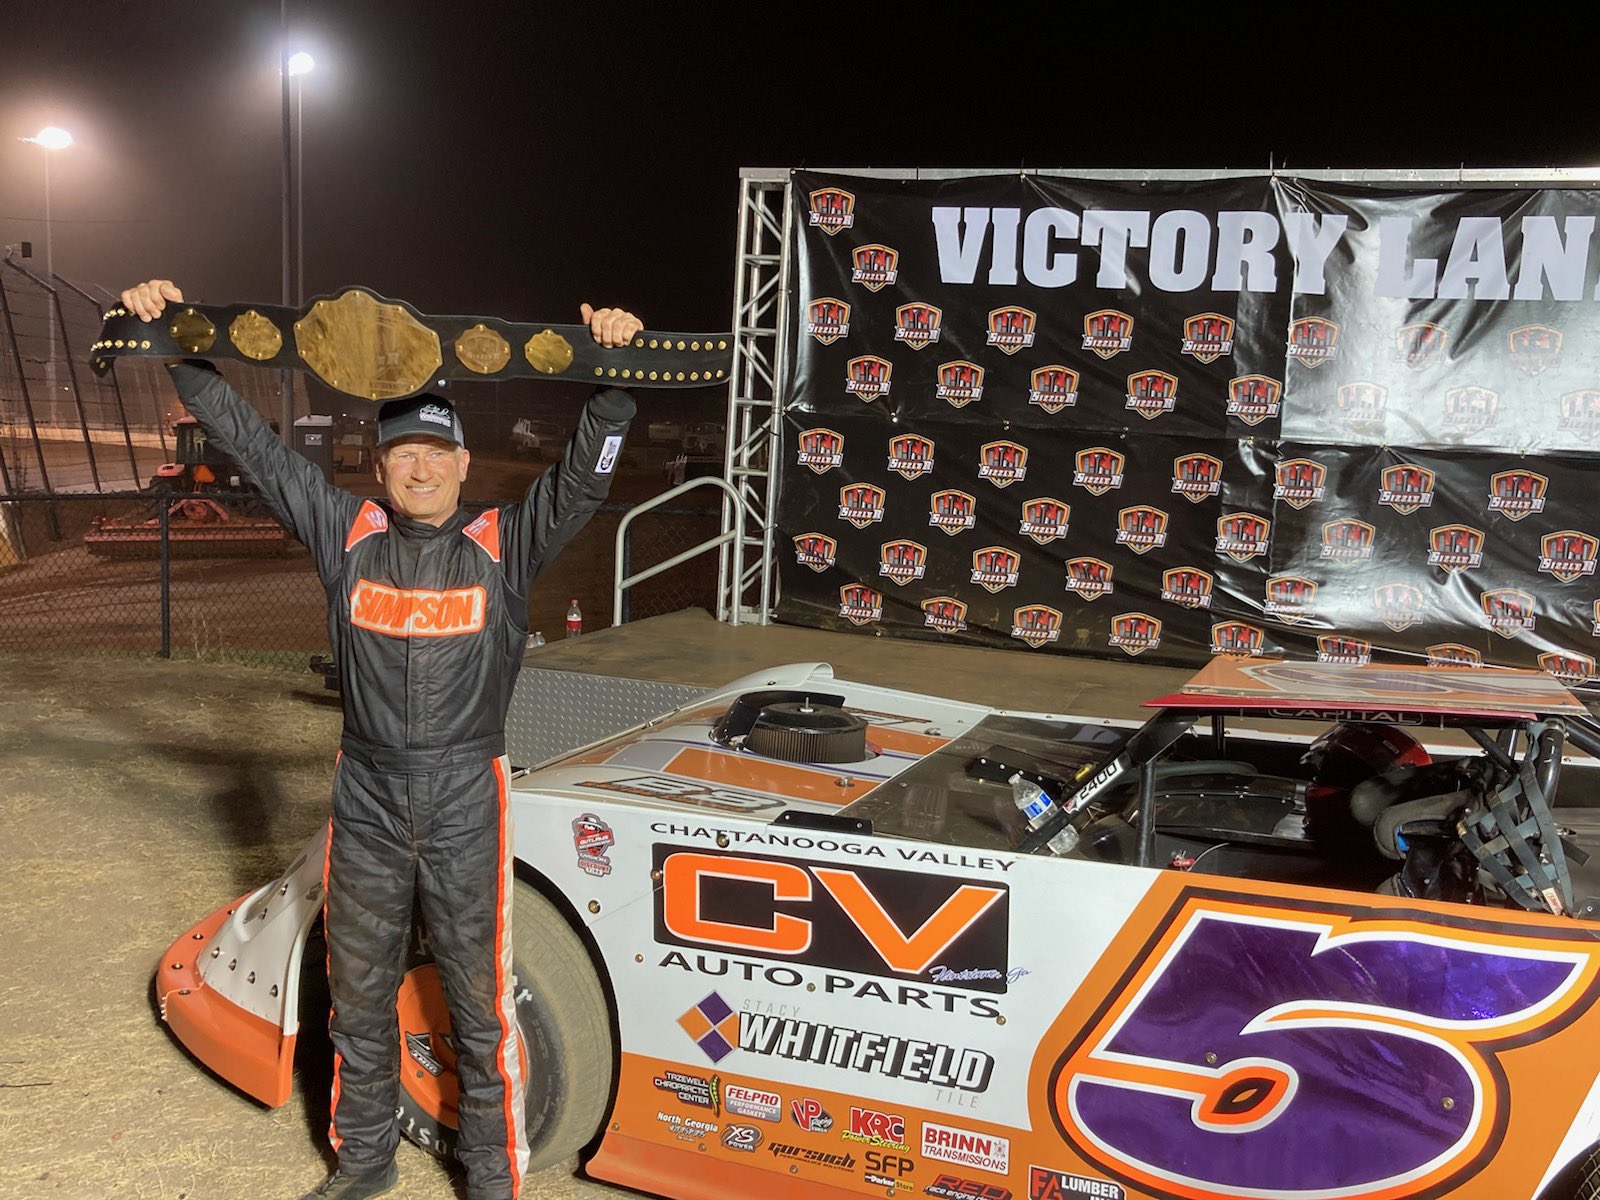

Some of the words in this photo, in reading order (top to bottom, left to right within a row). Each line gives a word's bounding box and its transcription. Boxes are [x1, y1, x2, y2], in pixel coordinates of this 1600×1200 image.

[812, 212, 852, 226] SIZZLER
[931, 206, 1348, 295] VICTORY
[1372, 215, 1600, 301] LAN
[854, 269, 894, 281] SIZZLER
[806, 323, 847, 335] SIZZLER
[896, 328, 938, 340] SIZZLER
[989, 332, 1033, 344] SIZZLER
[1084, 336, 1130, 348] SIZZLER
[1184, 340, 1230, 352] SIZZLER
[1288, 344, 1336, 356] SIZZLER
[848, 380, 888, 392] SIZZLER
[939, 386, 980, 398] SIZZLER
[1031, 391, 1075, 404] SIZZLER
[1128, 396, 1173, 409] SIZZLER
[1228, 401, 1278, 414] SIZZLER
[800, 452, 840, 464] SIZZLER
[890, 459, 932, 470] SIZZLER
[980, 464, 1023, 478] SIZZLER
[1076, 473, 1121, 485] SIZZLER
[1174, 480, 1218, 492] SIZZLER
[1276, 486, 1322, 498] SIZZLER
[1381, 491, 1430, 504] SIZZLER
[1491, 497, 1542, 510] SIZZLER
[841, 508, 882, 519] SIZZLER
[931, 513, 974, 525] SIZZLER
[1022, 522, 1066, 535] SIZZLER
[1119, 531, 1164, 544] SIZZLER
[1218, 539, 1266, 552] SIZZLER
[1323, 546, 1370, 558] SIZZLER
[1430, 552, 1480, 565] SIZZLER
[1541, 558, 1593, 572] SIZZLER
[881, 563, 922, 576] SIZZLER
[973, 571, 1016, 583] SIZZLER
[1068, 578, 1111, 590] SIZZLER
[354, 588, 473, 630] SIMPSON
[842, 606, 880, 617] SIZZLER
[1013, 628, 1057, 639] SIZZLER
[1111, 636, 1157, 647] SIZZLER
[1319, 653, 1368, 664] SIZZLER
[1080, 761, 1117, 800] 2400
[650, 822, 886, 858] CHATTANOOGA
[897, 848, 1016, 872] VALLEY
[663, 853, 1007, 974] CV
[658, 951, 803, 986] AUTO
[825, 974, 1000, 1018] PARTS
[743, 999, 800, 1017] STACY
[738, 1011, 995, 1094] WHITFIELD
[1055, 897, 1598, 1200] 5
[678, 1092, 710, 1105] CENTER
[728, 1087, 779, 1106] FEL-PRO
[936, 1089, 979, 1109] TILE
[730, 1100, 777, 1114] PERFORMANCE
[737, 1108, 766, 1119] GASKETS
[791, 1098, 822, 1132] VP
[657, 1112, 681, 1124] North
[684, 1118, 718, 1132] Georgia
[850, 1107, 904, 1144] KRC
[722, 1124, 754, 1142] XS
[728, 1140, 754, 1150] POWER
[925, 1128, 991, 1156] BRINN
[865, 1150, 915, 1177] SFP
[924, 1145, 1007, 1171] TRANSMISSIONS
[870, 1174, 894, 1187] Parker
[895, 1181, 914, 1191] Store
[933, 1174, 1009, 1200] RED
[1062, 1176, 1118, 1199] LUMBER
